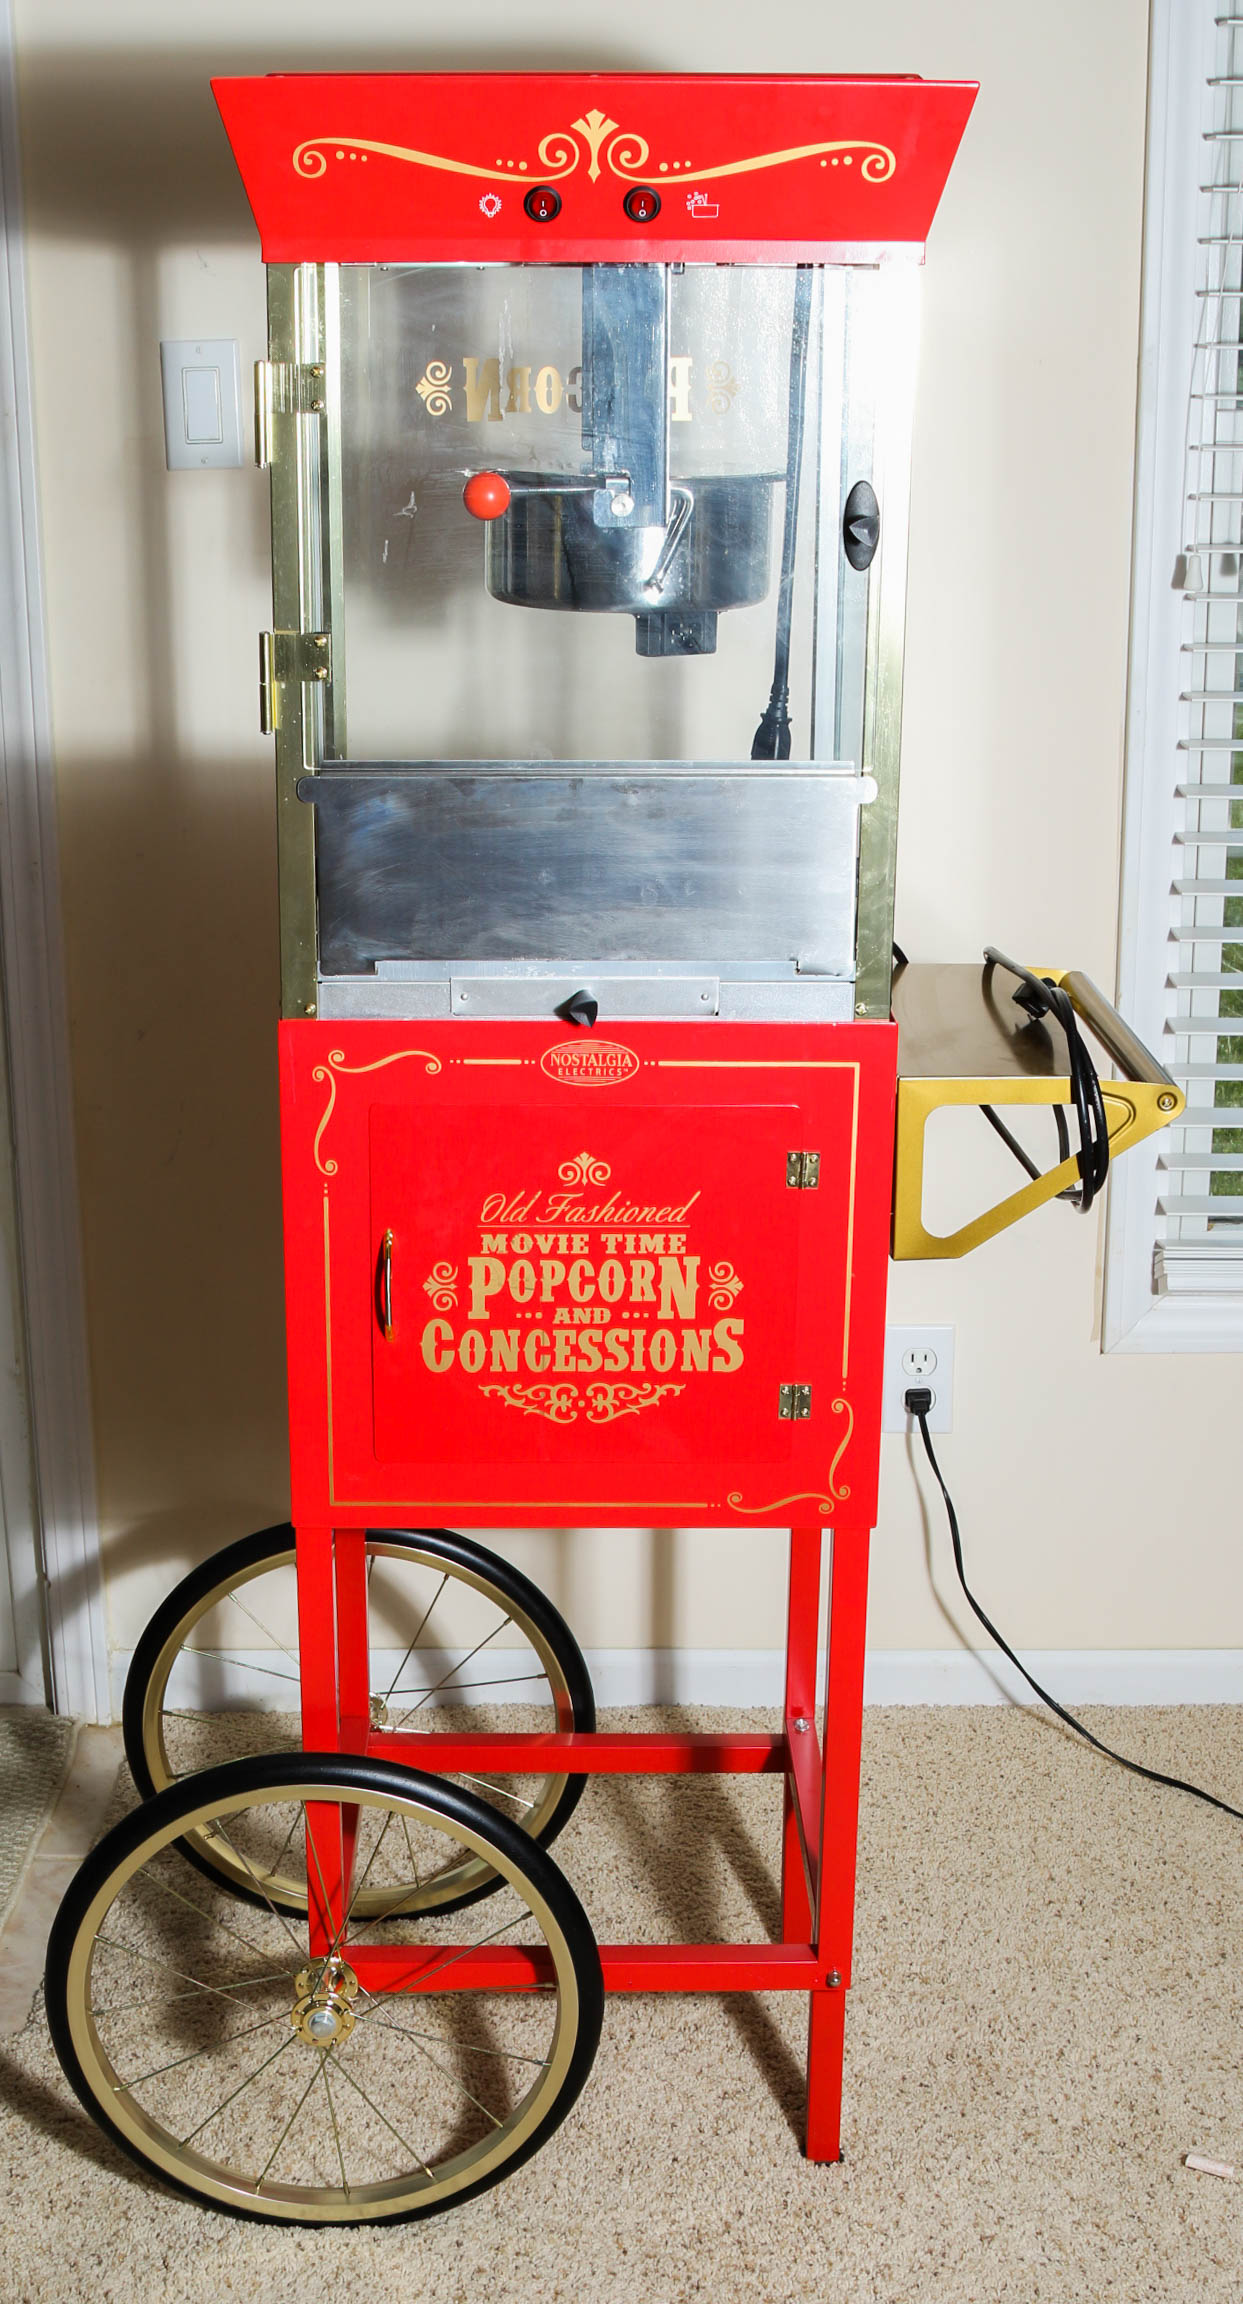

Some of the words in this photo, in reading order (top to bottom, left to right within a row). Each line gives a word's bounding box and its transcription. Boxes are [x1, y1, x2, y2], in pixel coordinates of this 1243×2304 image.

[550, 1053, 633, 1067] NOSTALGIA
[480, 1190, 541, 1223] Old
[536, 1190, 701, 1223] Fashioned
[481, 1234, 590, 1254] MOVIE
[600, 1234, 686, 1254] TIME
[467, 1256, 701, 1320] POPCORN
[553, 1307, 611, 1325] AND
[420, 1318, 745, 1373] CONCESSIONS
